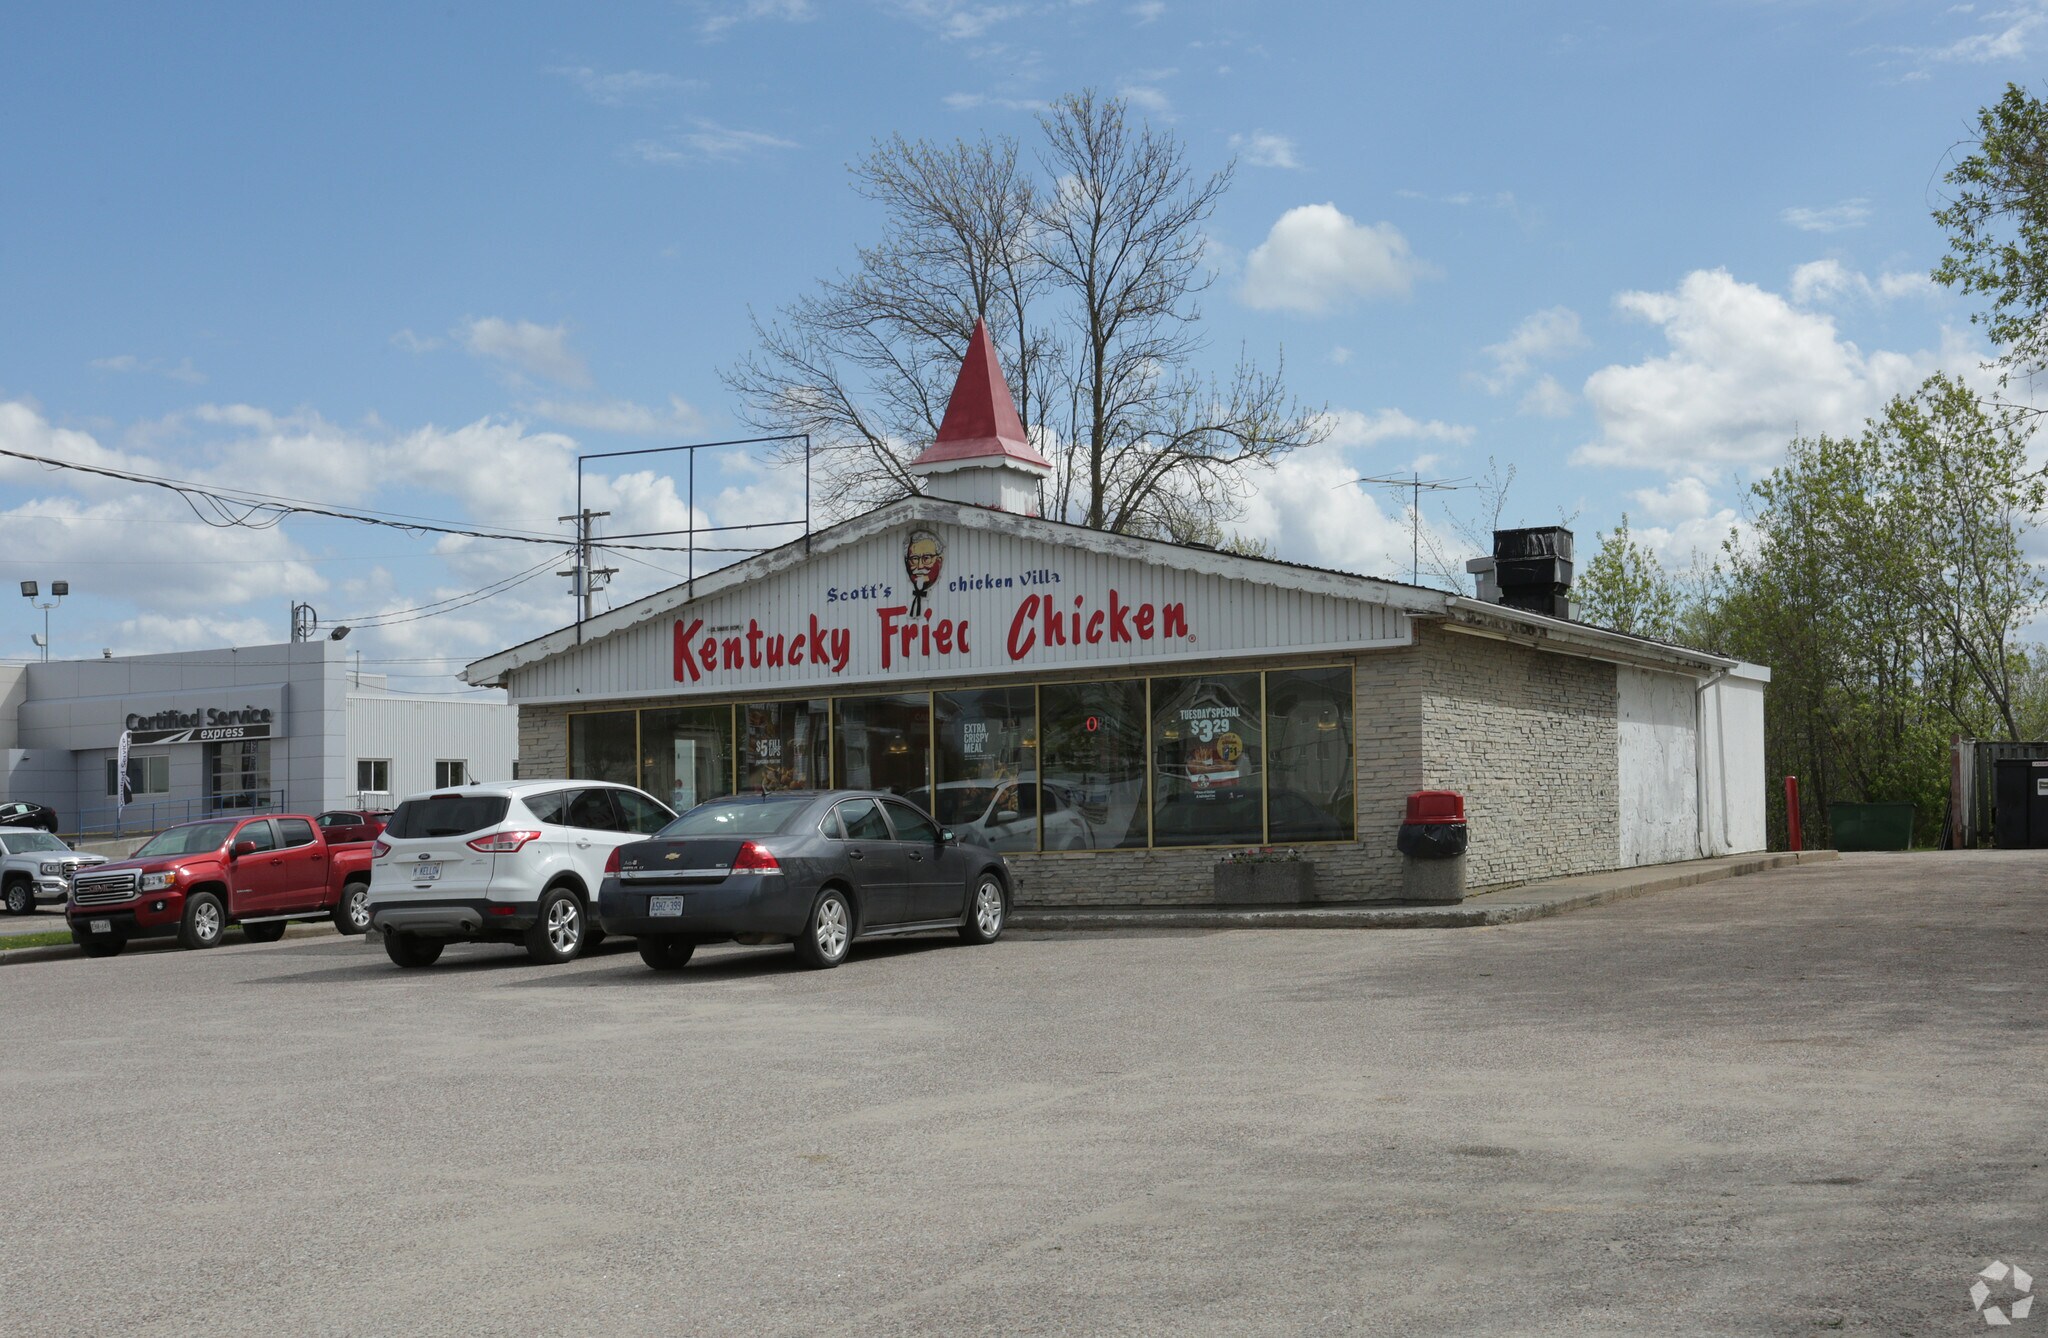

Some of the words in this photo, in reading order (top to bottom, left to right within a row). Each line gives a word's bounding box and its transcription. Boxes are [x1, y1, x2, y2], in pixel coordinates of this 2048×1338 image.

[827, 583, 892, 602] Scott's
[949, 575, 1013, 592] chicken
[673, 613, 850, 683] Kentucky
[1007, 588, 1188, 660] Chicken
[126, 708, 201, 731] Certified
[206, 705, 273, 726] Service
[1180, 707, 1211, 720] TUESDAY
[1211, 706, 1240, 718] SPECIAL
[200, 727, 244, 741] express
[964, 723, 986, 734] EXTRA
[963, 732, 989, 743] CRISPY
[756, 739, 768, 757] $5
[768, 739, 781, 748] FILL
[964, 743, 983, 753] MEAL
